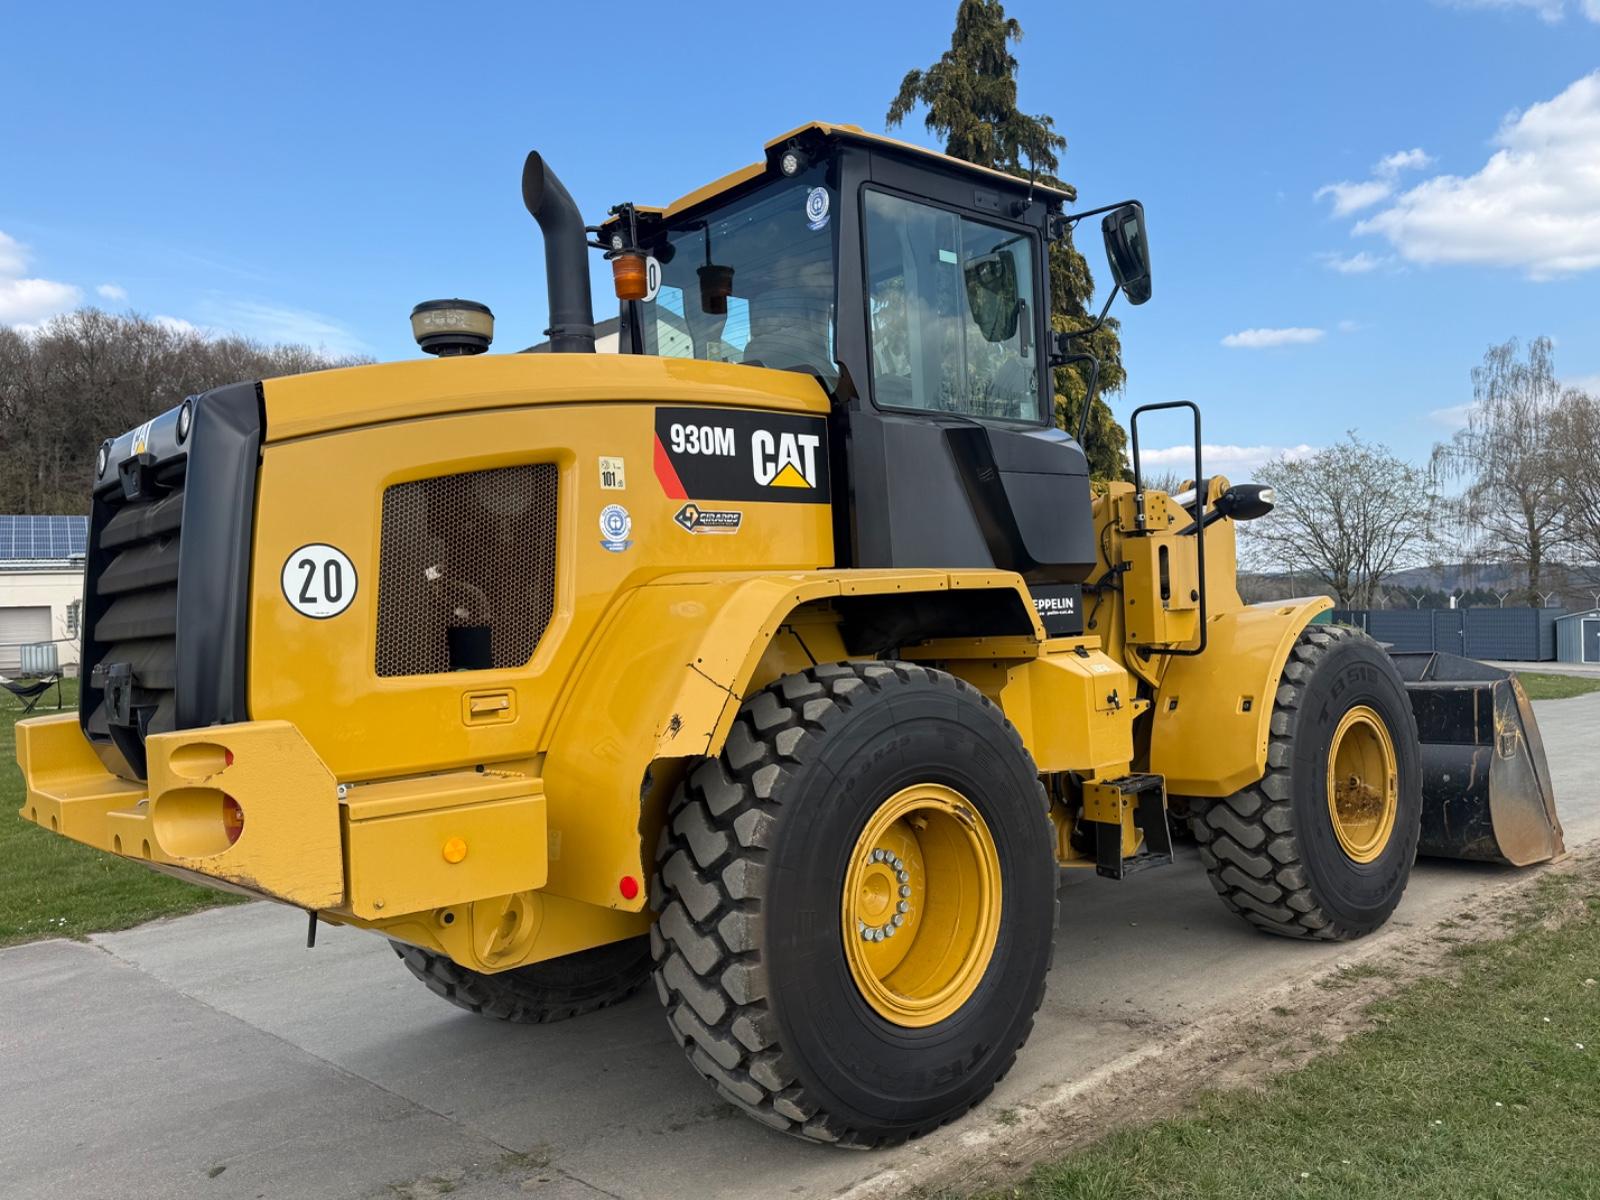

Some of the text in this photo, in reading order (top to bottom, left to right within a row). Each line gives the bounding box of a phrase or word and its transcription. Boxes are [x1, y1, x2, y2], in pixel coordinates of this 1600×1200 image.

[670, 423, 820, 489] 930M CAT
[602, 471, 616, 487] 101
[298, 558, 343, 604] 20
[1032, 597, 1073, 609] EPPELIN
